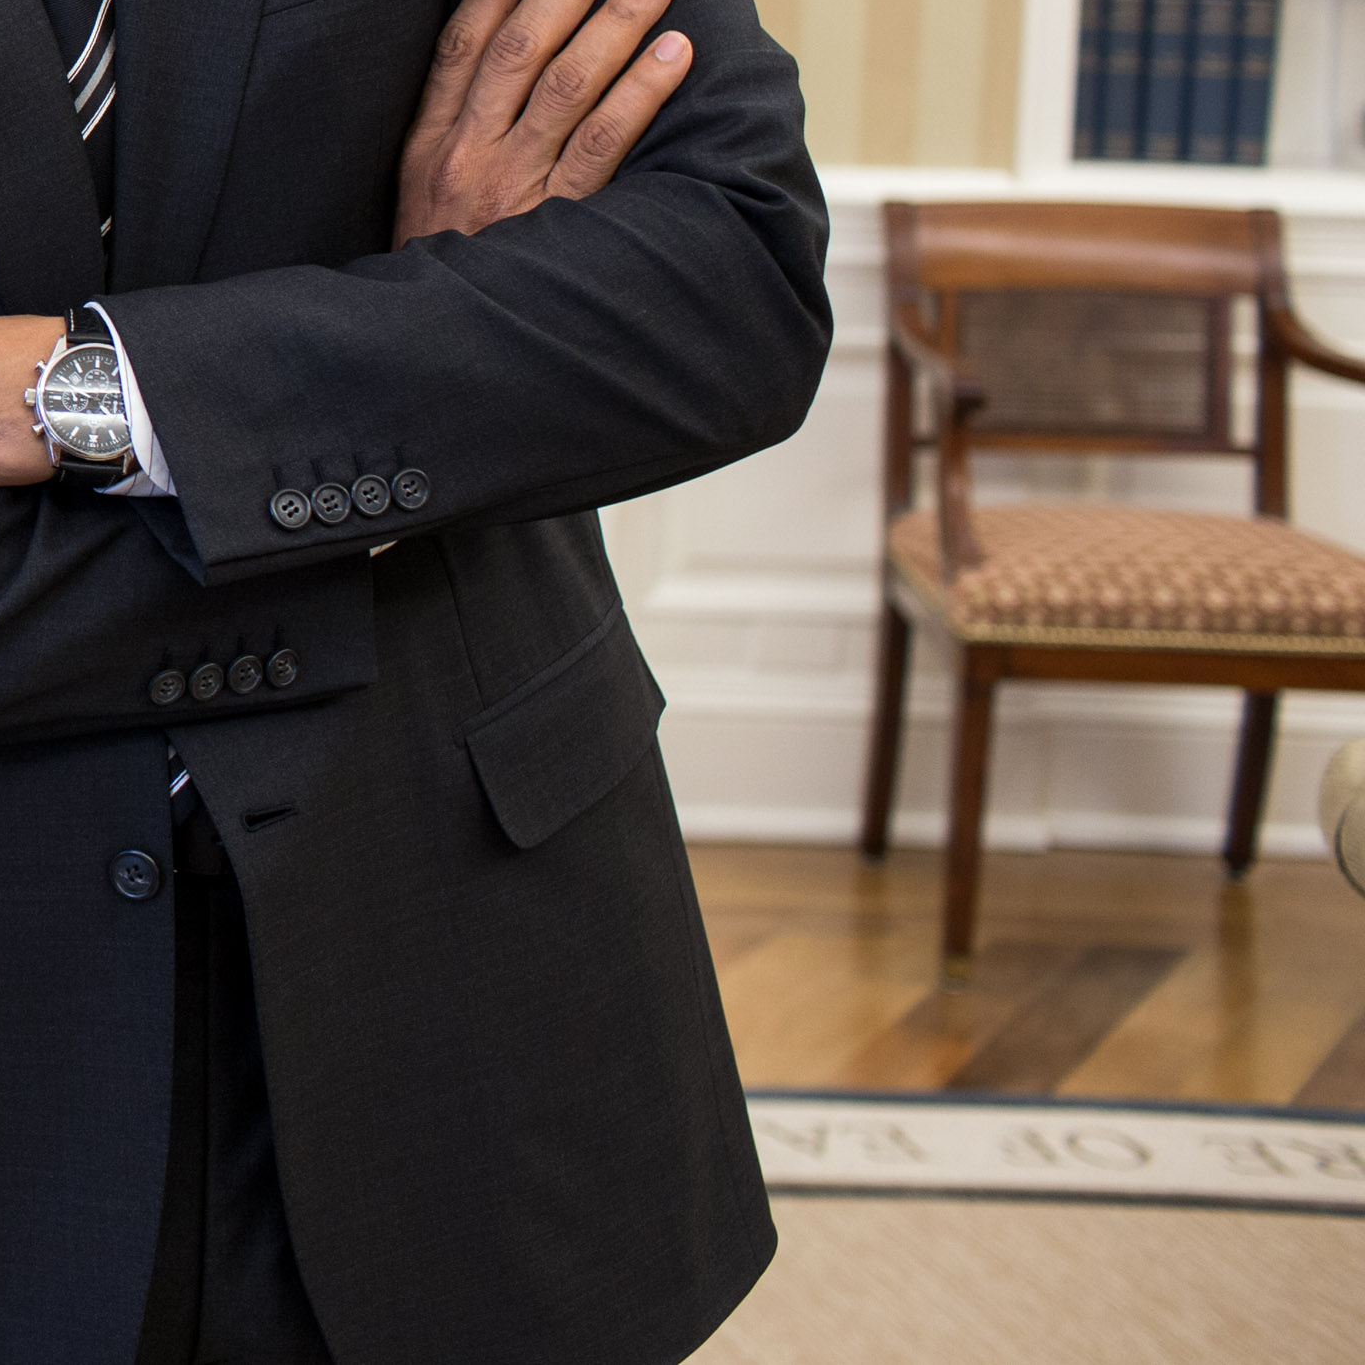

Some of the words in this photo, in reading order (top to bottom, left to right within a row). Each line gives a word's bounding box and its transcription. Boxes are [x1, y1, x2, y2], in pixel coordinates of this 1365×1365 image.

[754, 1116, 932, 1167] EA
[998, 1118, 1153, 1173] OF
[1200, 1133, 1365, 1182] RE
